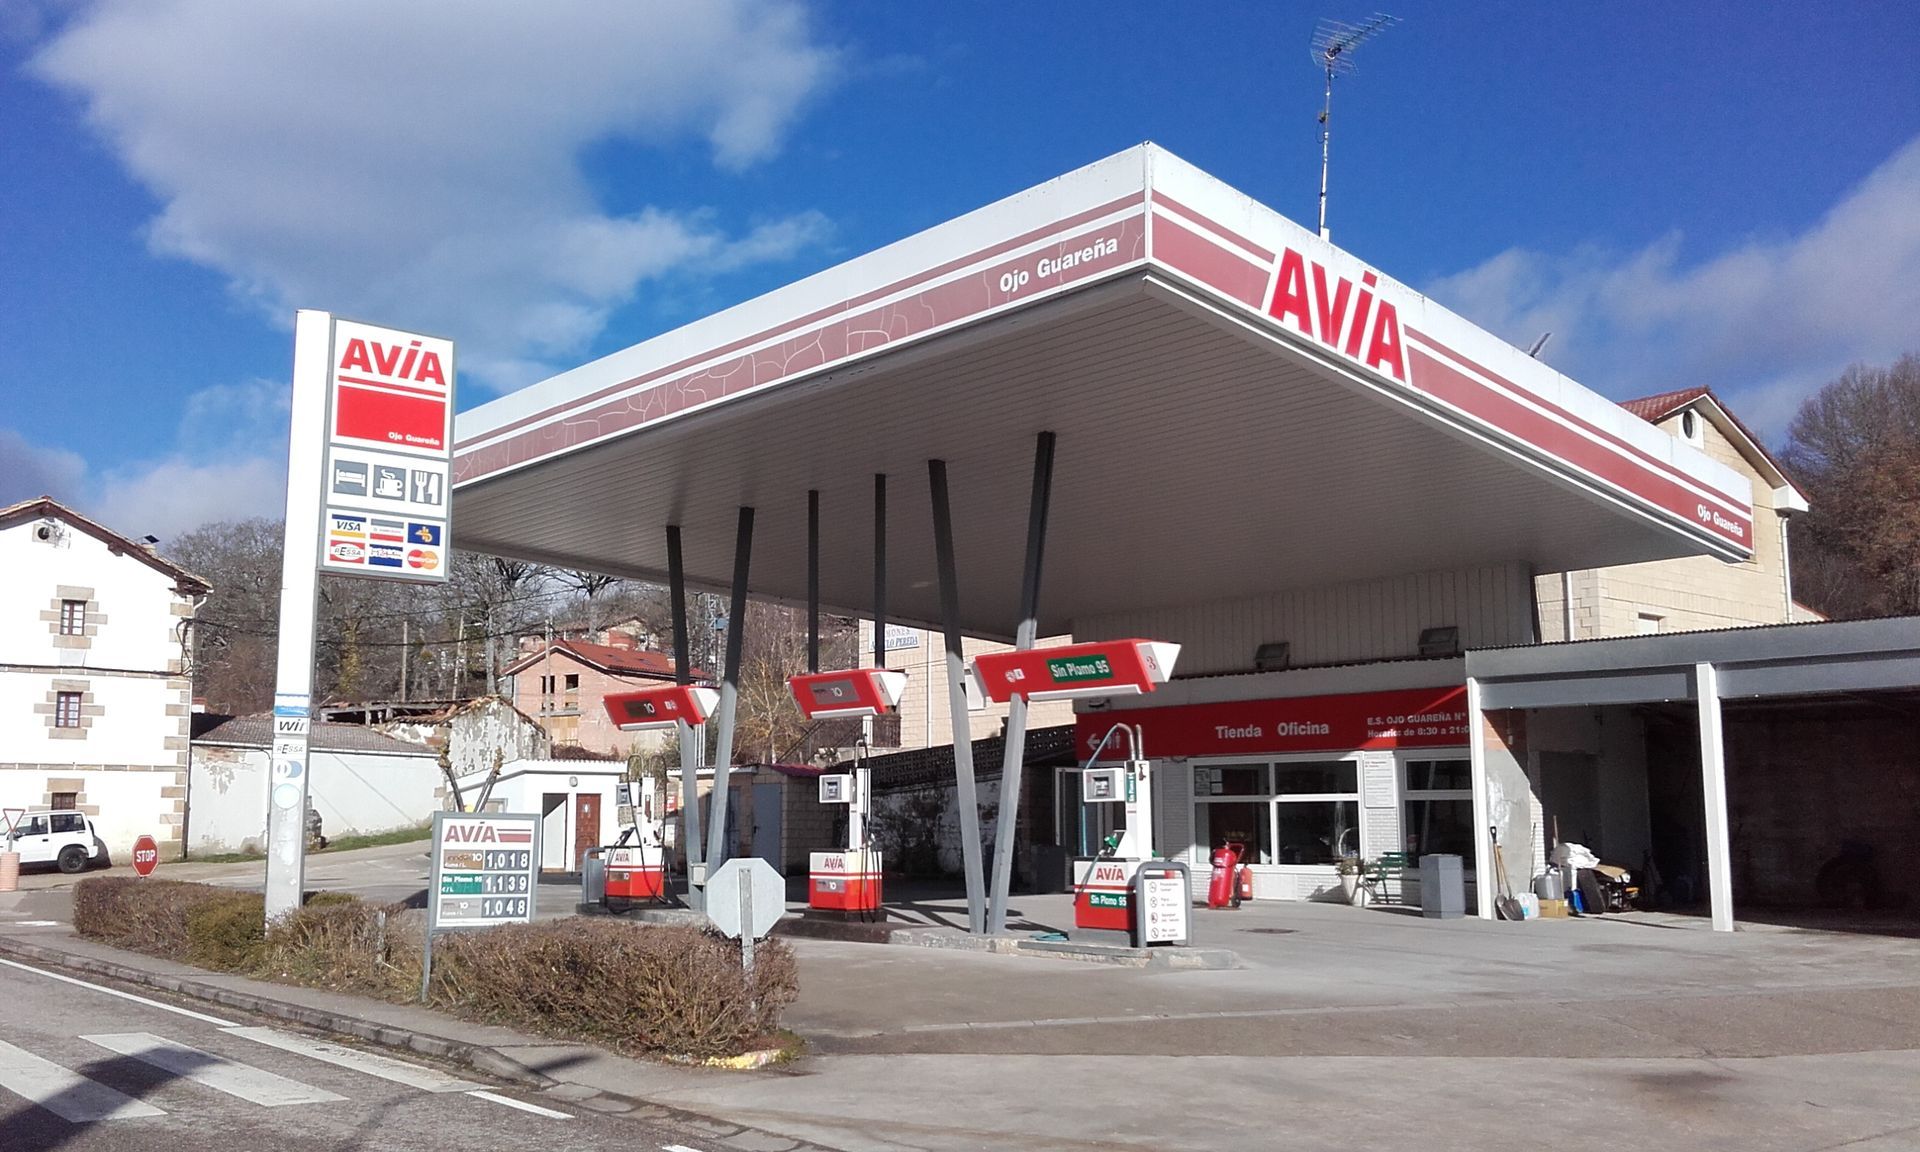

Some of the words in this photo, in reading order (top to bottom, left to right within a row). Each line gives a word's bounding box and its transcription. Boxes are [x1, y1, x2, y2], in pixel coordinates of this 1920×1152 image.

[1000, 269, 1029, 292] Ojo
[1037, 238, 1118, 278] Guareña
[388, 432, 403, 441] Ojo
[405, 434, 440, 446] Guareña
[336, 520, 361, 532] VISA
[1697, 504, 1711, 522] Ojo
[1713, 511, 1744, 538] Guareña
[1051, 663, 1066, 678] Sin
[1068, 661, 1096, 676] Plomo
[1096, 659, 1110, 674] 95
[1367, 717, 1384, 726] E.S.
[1386, 715, 1404, 724] OJO
[1407, 711, 1451, 723] GUAREÑA
[1215, 725, 1262, 739] Tienda
[1277, 721, 1329, 736] Oficina
[1368, 728, 1401, 738] Horario:
[1403, 728, 1414, 736] de
[1417, 726, 1438, 736] 8:30
[136, 849, 155, 863] STOP
[1091, 894, 1100, 904] Sin
[1100, 895, 1118, 905] Plomo
